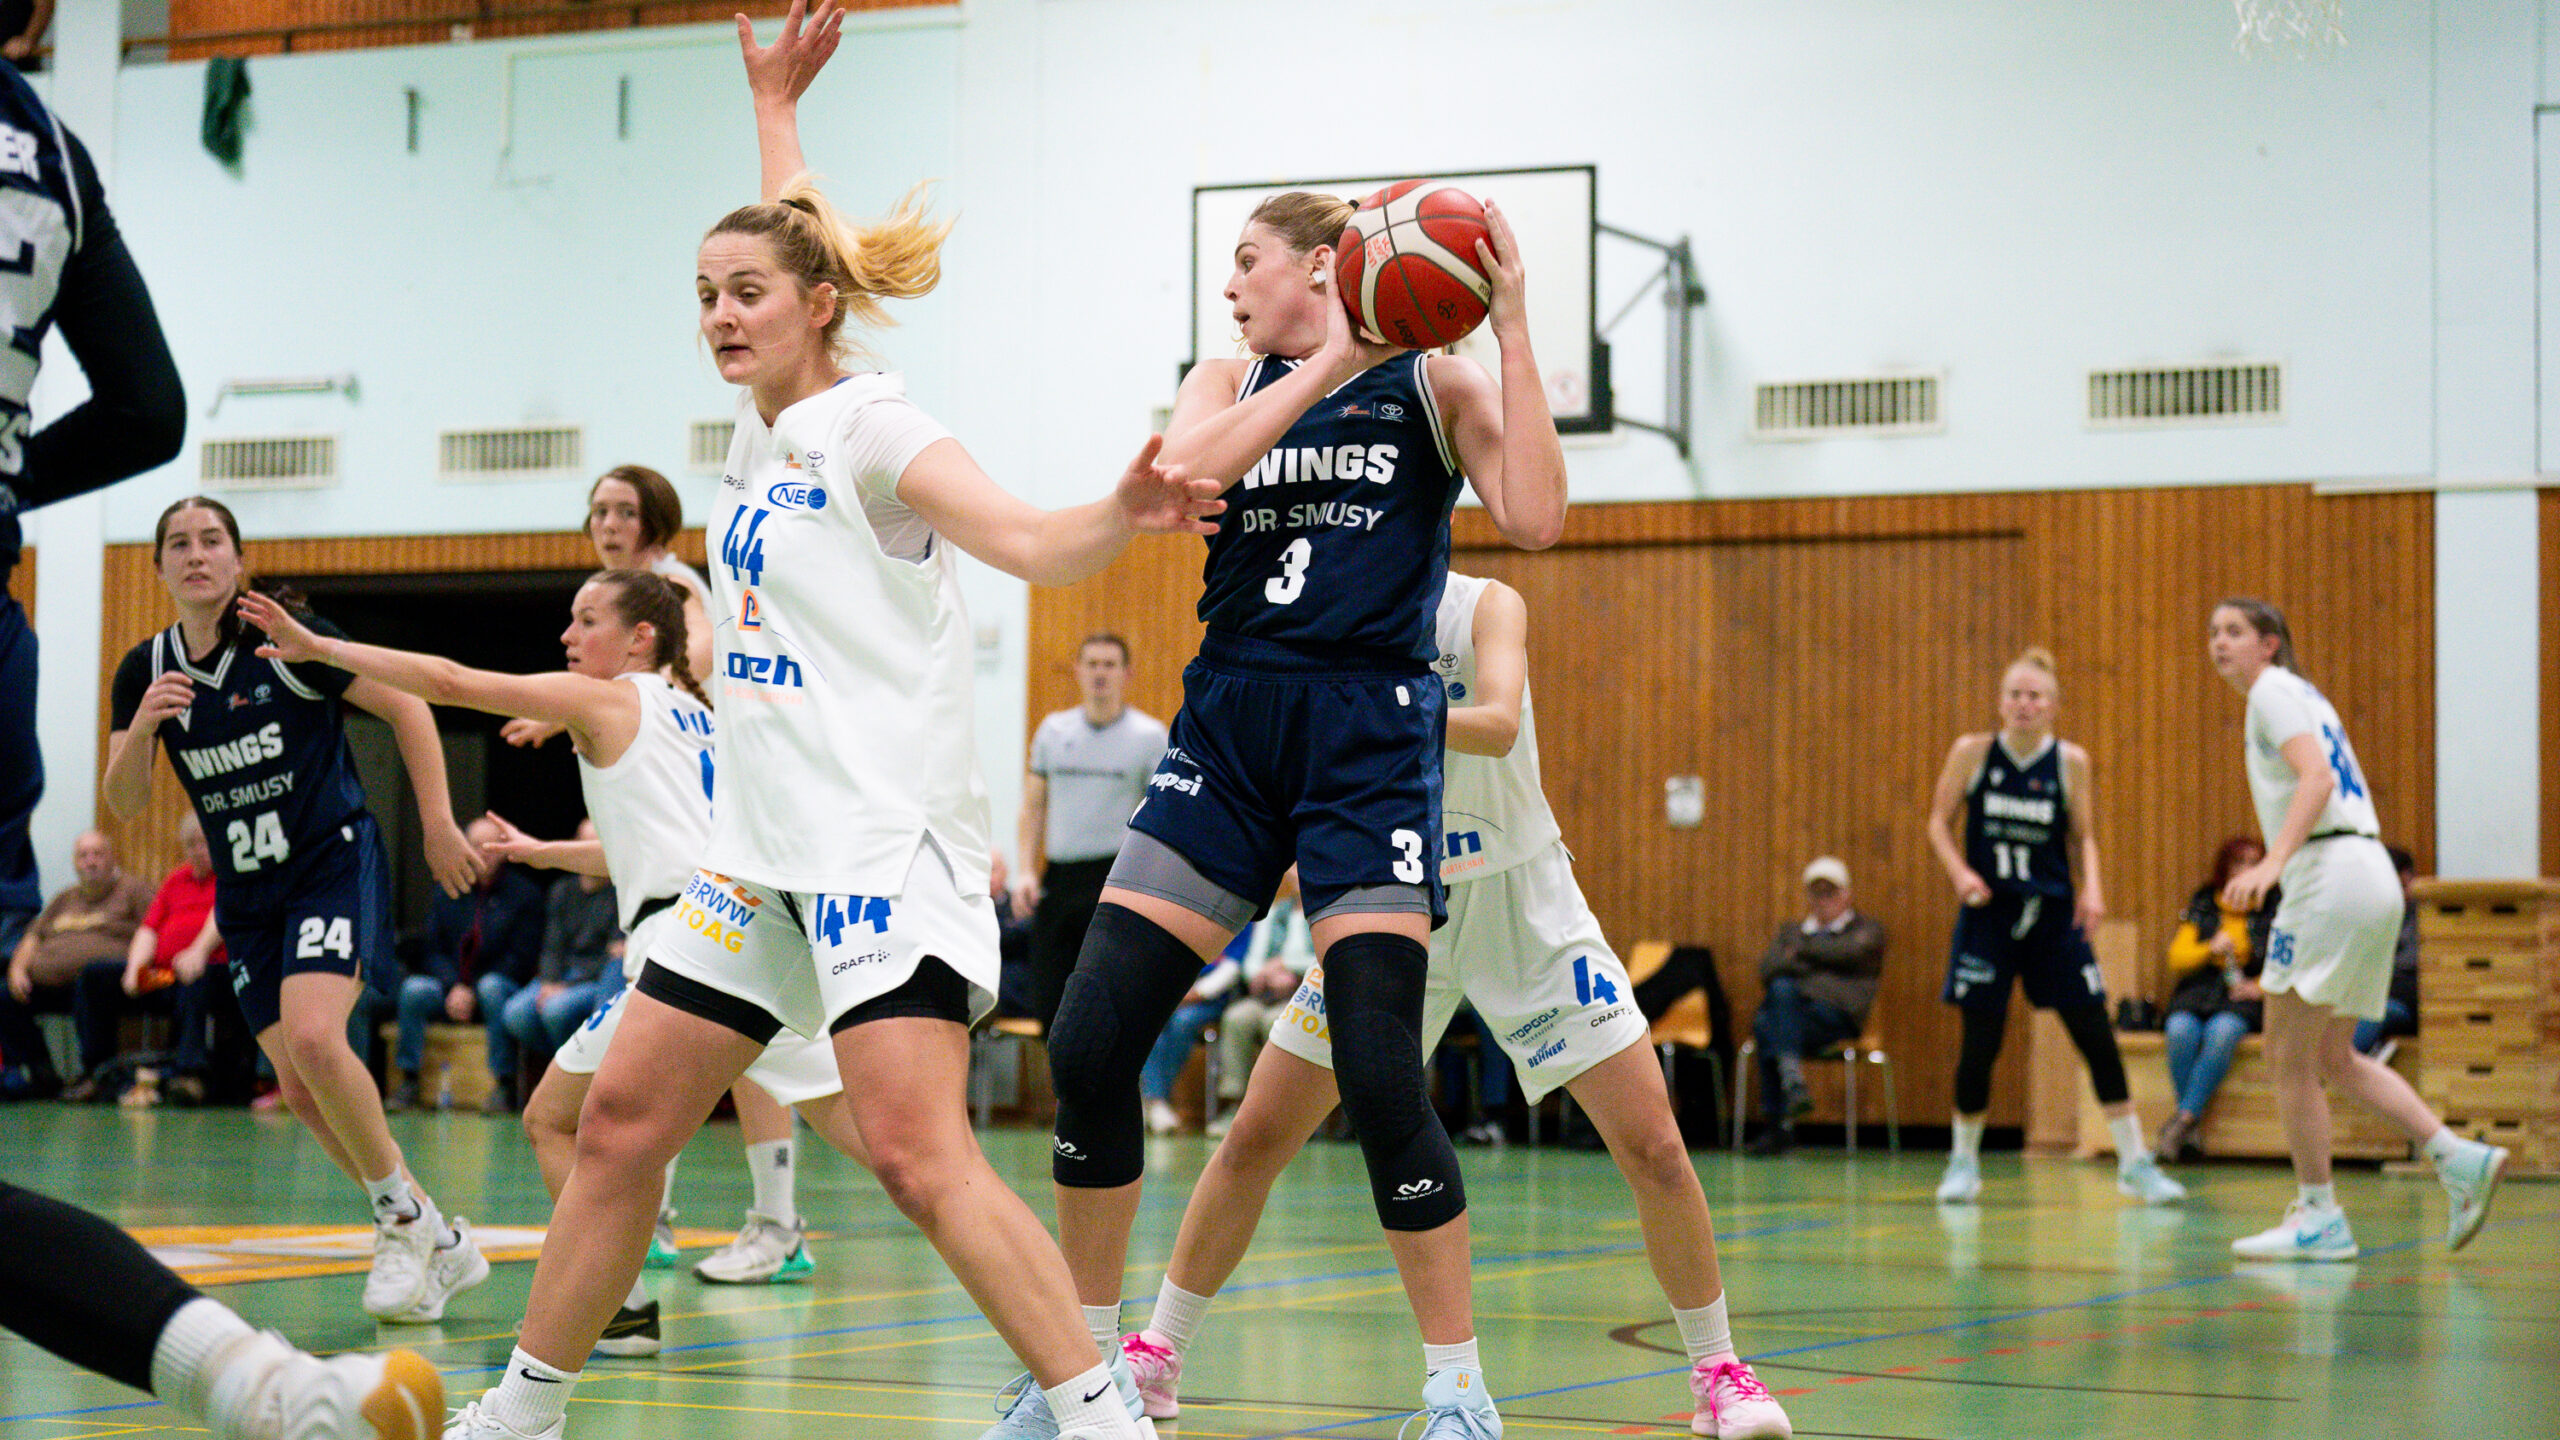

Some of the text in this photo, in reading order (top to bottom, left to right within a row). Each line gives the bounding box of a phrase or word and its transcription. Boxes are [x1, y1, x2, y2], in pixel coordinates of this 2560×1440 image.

[1243, 444, 1399, 490] WINGS
[1286, 502, 1384, 532] SMUSY
[722, 504, 770, 586] 44
[1264, 537, 1312, 605] 3
[722, 651, 803, 688] oeh
[179, 721, 284, 780] WINGS
[201, 770, 294, 814] DR. SMUSY
[226, 809, 290, 873] 24
[1391, 828, 1424, 885] 3
[1992, 841, 2032, 882] 11
[695, 881, 756, 928] RWW
[815, 894, 891, 948] 44
[296, 915, 353, 960] 24
[832, 953, 875, 975] CRAFT
[1573, 955, 1619, 1007] 4
[1508, 1007, 1560, 1042] TOPGOLF
[1590, 1008, 1626, 1028] CRAFT
